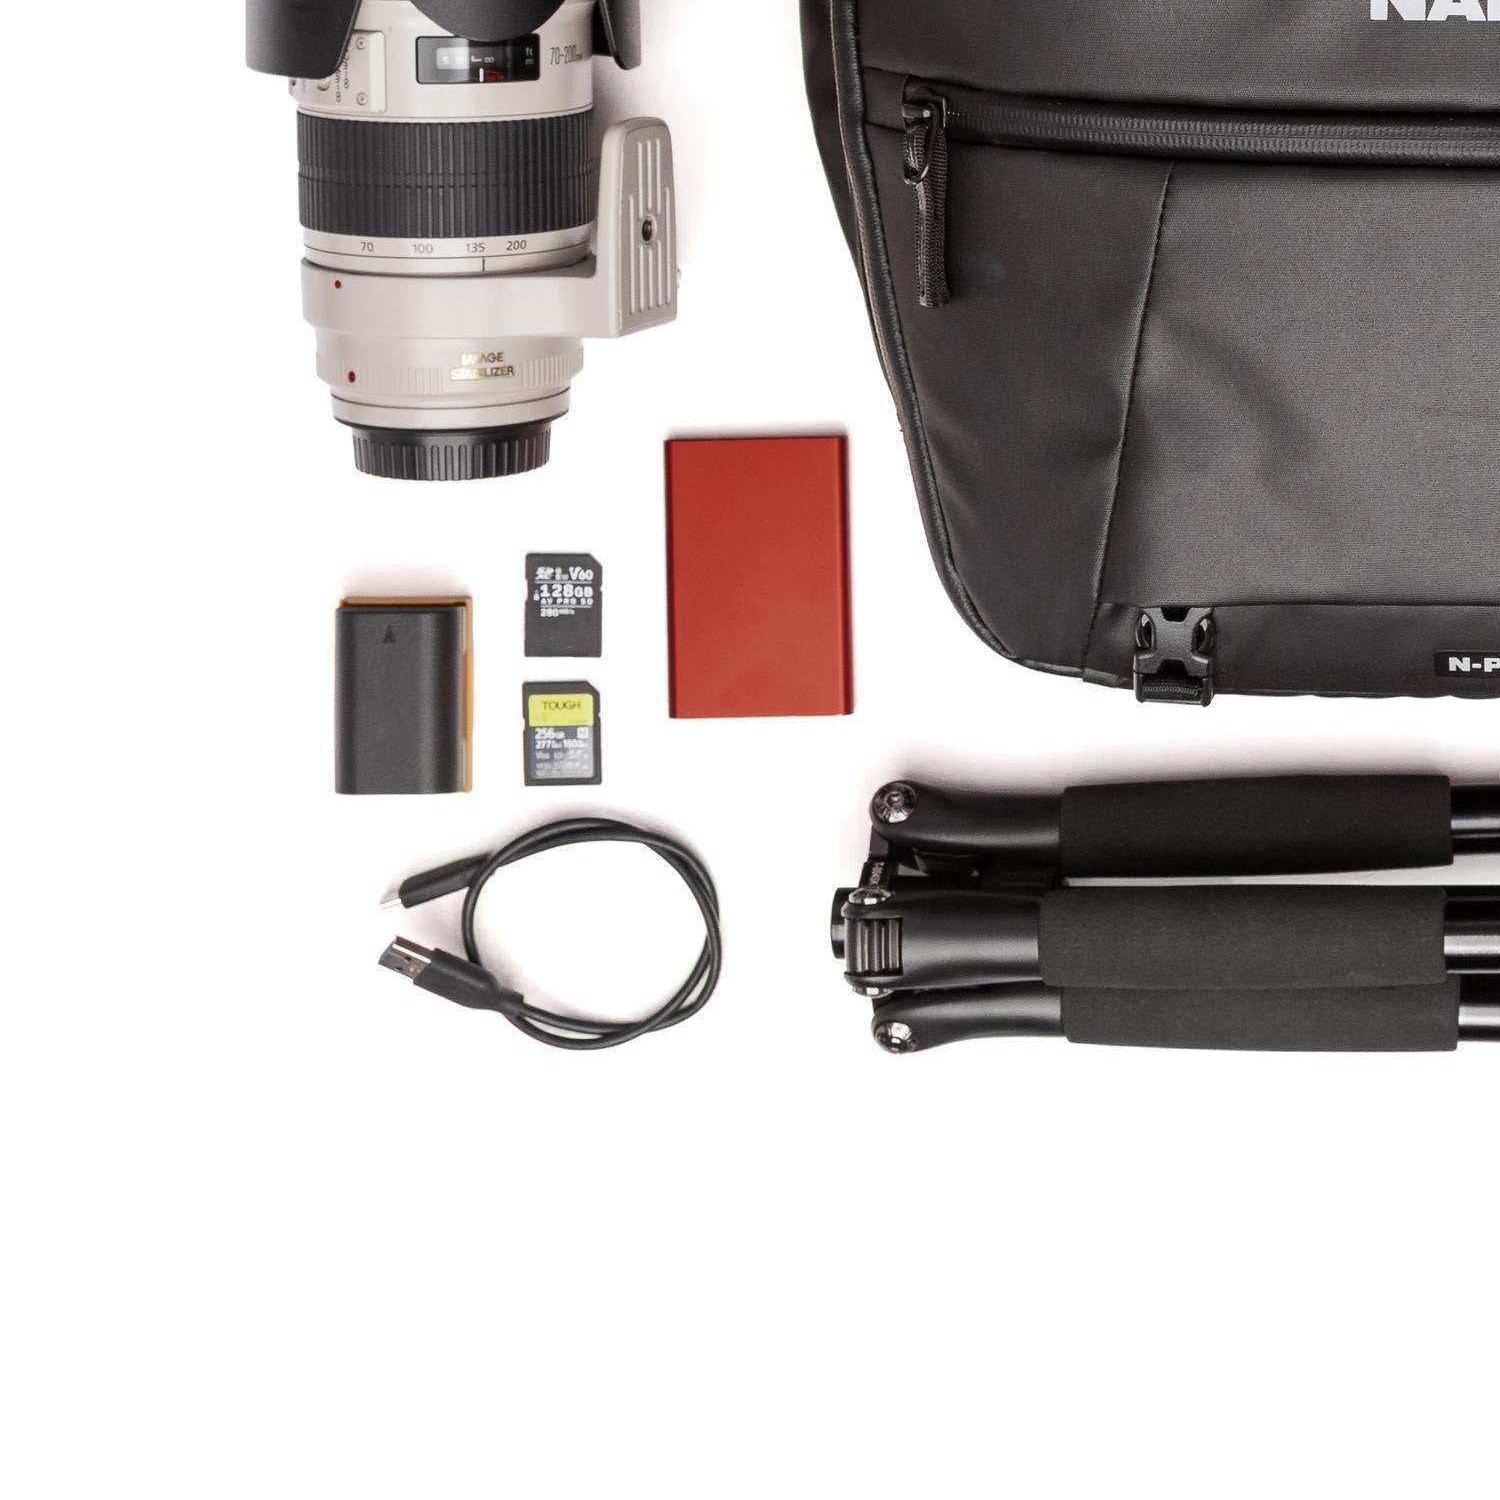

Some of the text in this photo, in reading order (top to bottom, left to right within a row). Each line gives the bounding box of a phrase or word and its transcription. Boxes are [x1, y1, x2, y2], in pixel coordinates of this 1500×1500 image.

[360, 239, 527, 254] 70 100 135 200
[461, 351, 504, 365] IMAGE
[450, 365, 515, 380] STABILIZER
[569, 566, 593, 580] V60
[540, 584, 593, 598] 128GB
[542, 700, 581, 710] TOUGH
